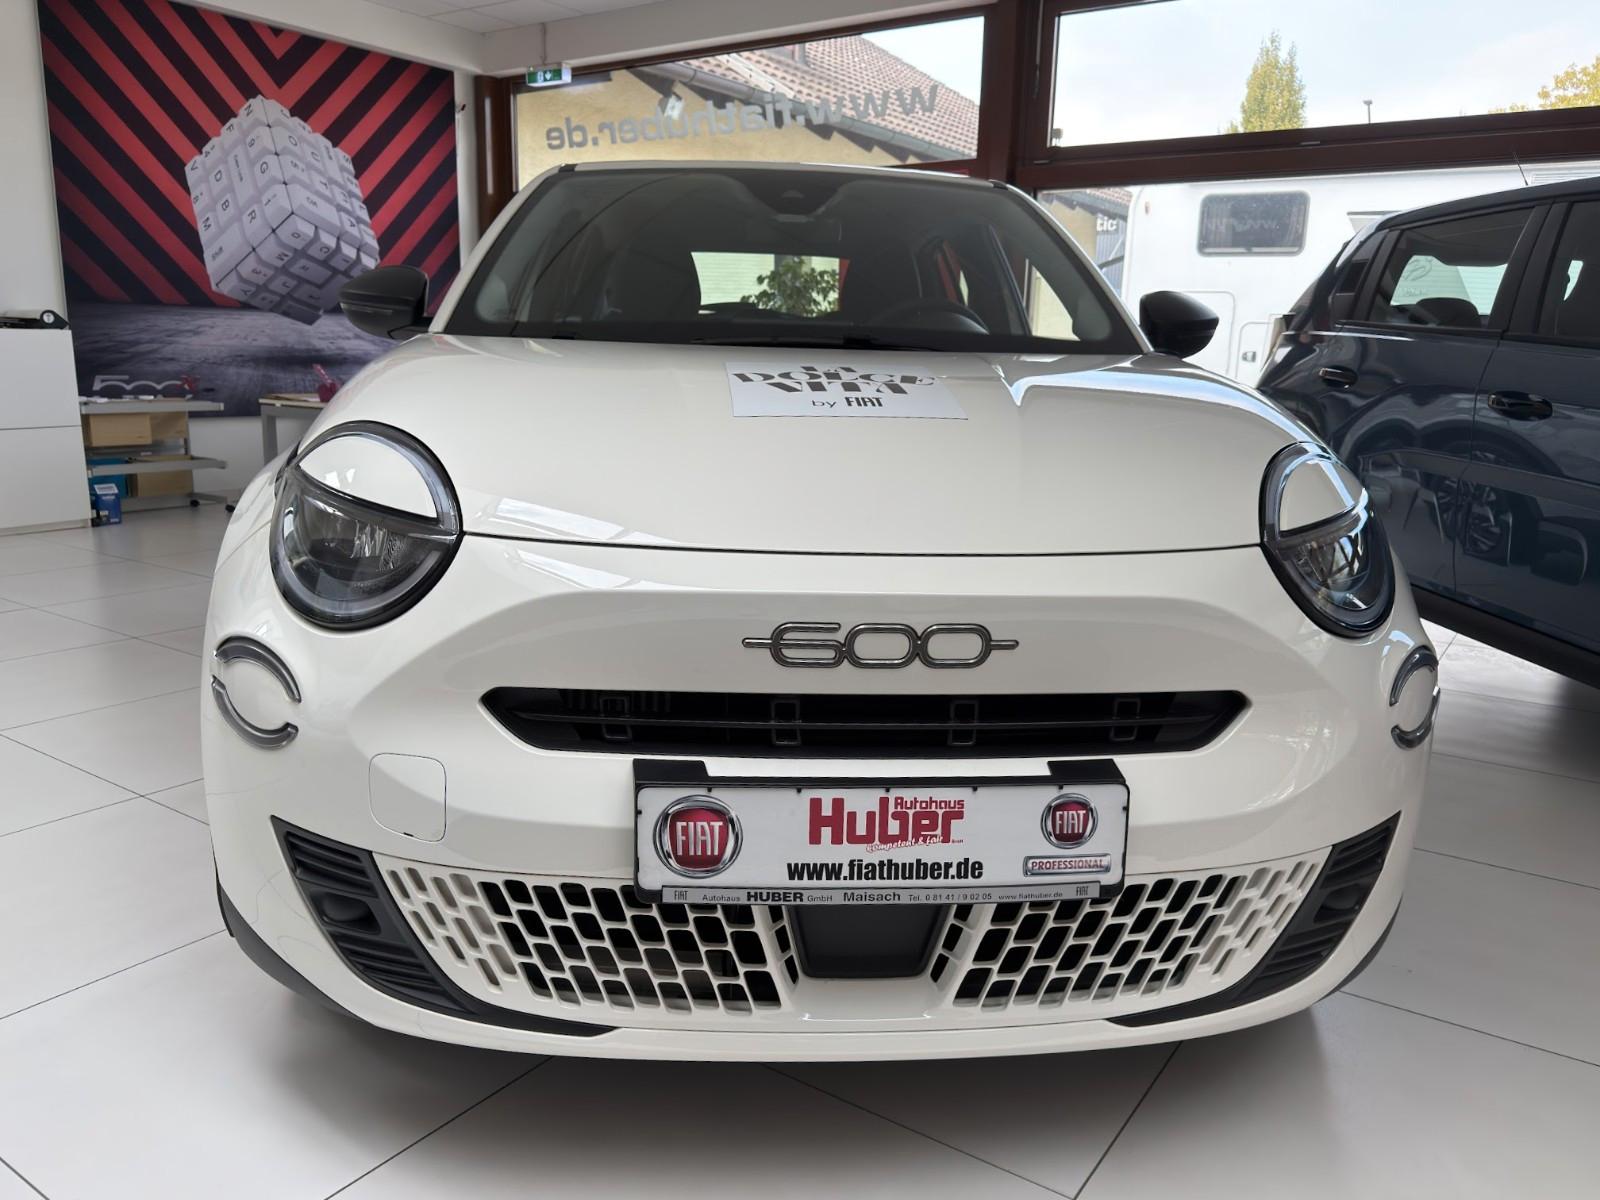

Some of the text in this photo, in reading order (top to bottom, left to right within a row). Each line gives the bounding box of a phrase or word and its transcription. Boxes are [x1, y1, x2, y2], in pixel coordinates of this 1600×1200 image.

[766, 380, 909, 395] VITA
[811, 396, 884, 408] by FIAT
[760, 621, 1002, 670] 600
[894, 796, 966, 811] Autohaus
[808, 796, 965, 846] Huber
[1055, 809, 1087, 835] FIAT
[675, 821, 724, 857] FIAT
[786, 857, 984, 882] www.fiathuber.de
[1030, 858, 1106, 872] PROFESSIONAL
[673, 890, 689, 901] FIAT
[702, 893, 741, 903] Autohaus
[746, 891, 804, 903] HUBER
[807, 894, 833, 903] GmbH
[843, 891, 901, 903] Maisach
[909, 893, 921, 902] Tel.
[998, 890, 1064, 901] www.fiathuber.de
[1075, 885, 1089, 897] FIAT
